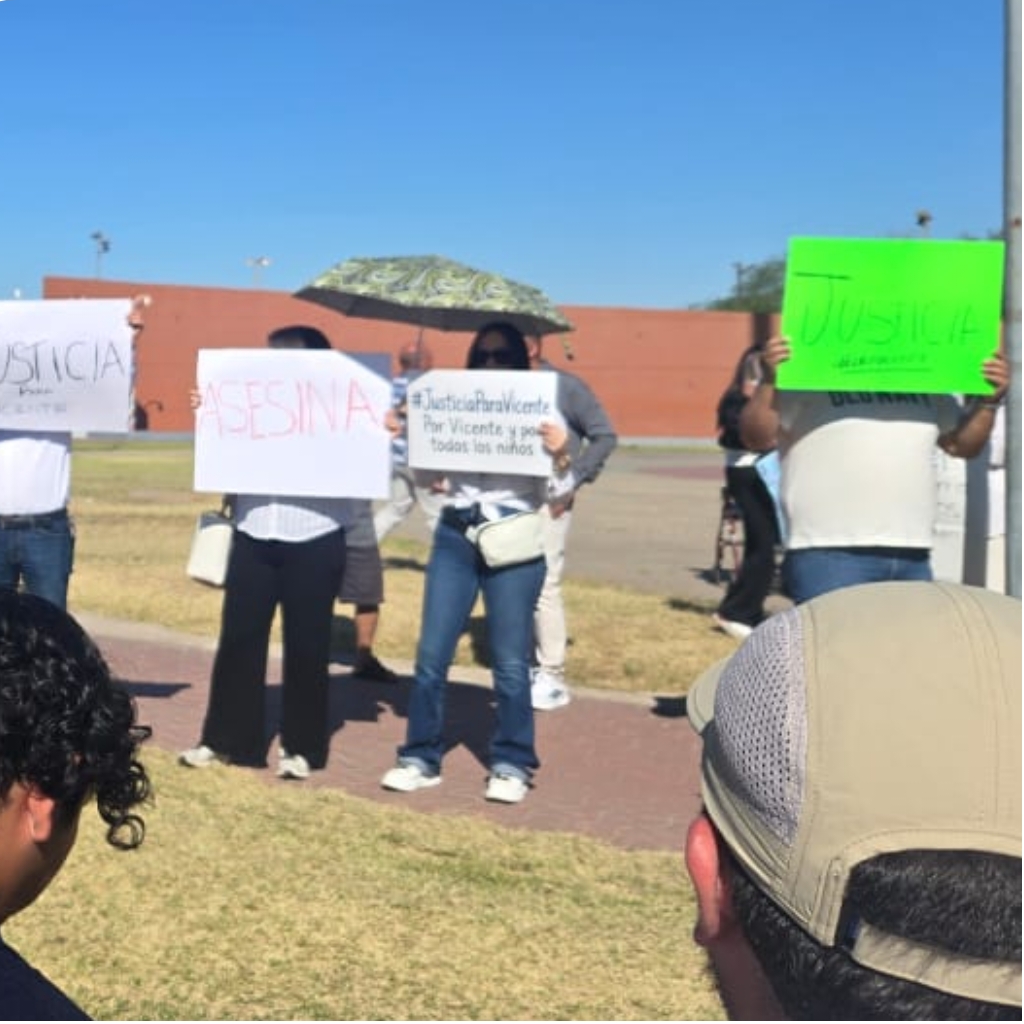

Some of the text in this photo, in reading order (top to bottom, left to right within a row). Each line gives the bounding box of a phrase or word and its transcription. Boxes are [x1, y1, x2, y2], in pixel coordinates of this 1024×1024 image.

[199, 378, 381, 441] ASESINA
[411, 387, 550, 416] #JusticiaParaVicente
[424, 414, 444, 434] Por
[450, 417, 504, 436] Vicente
[509, 424, 517, 442] y
